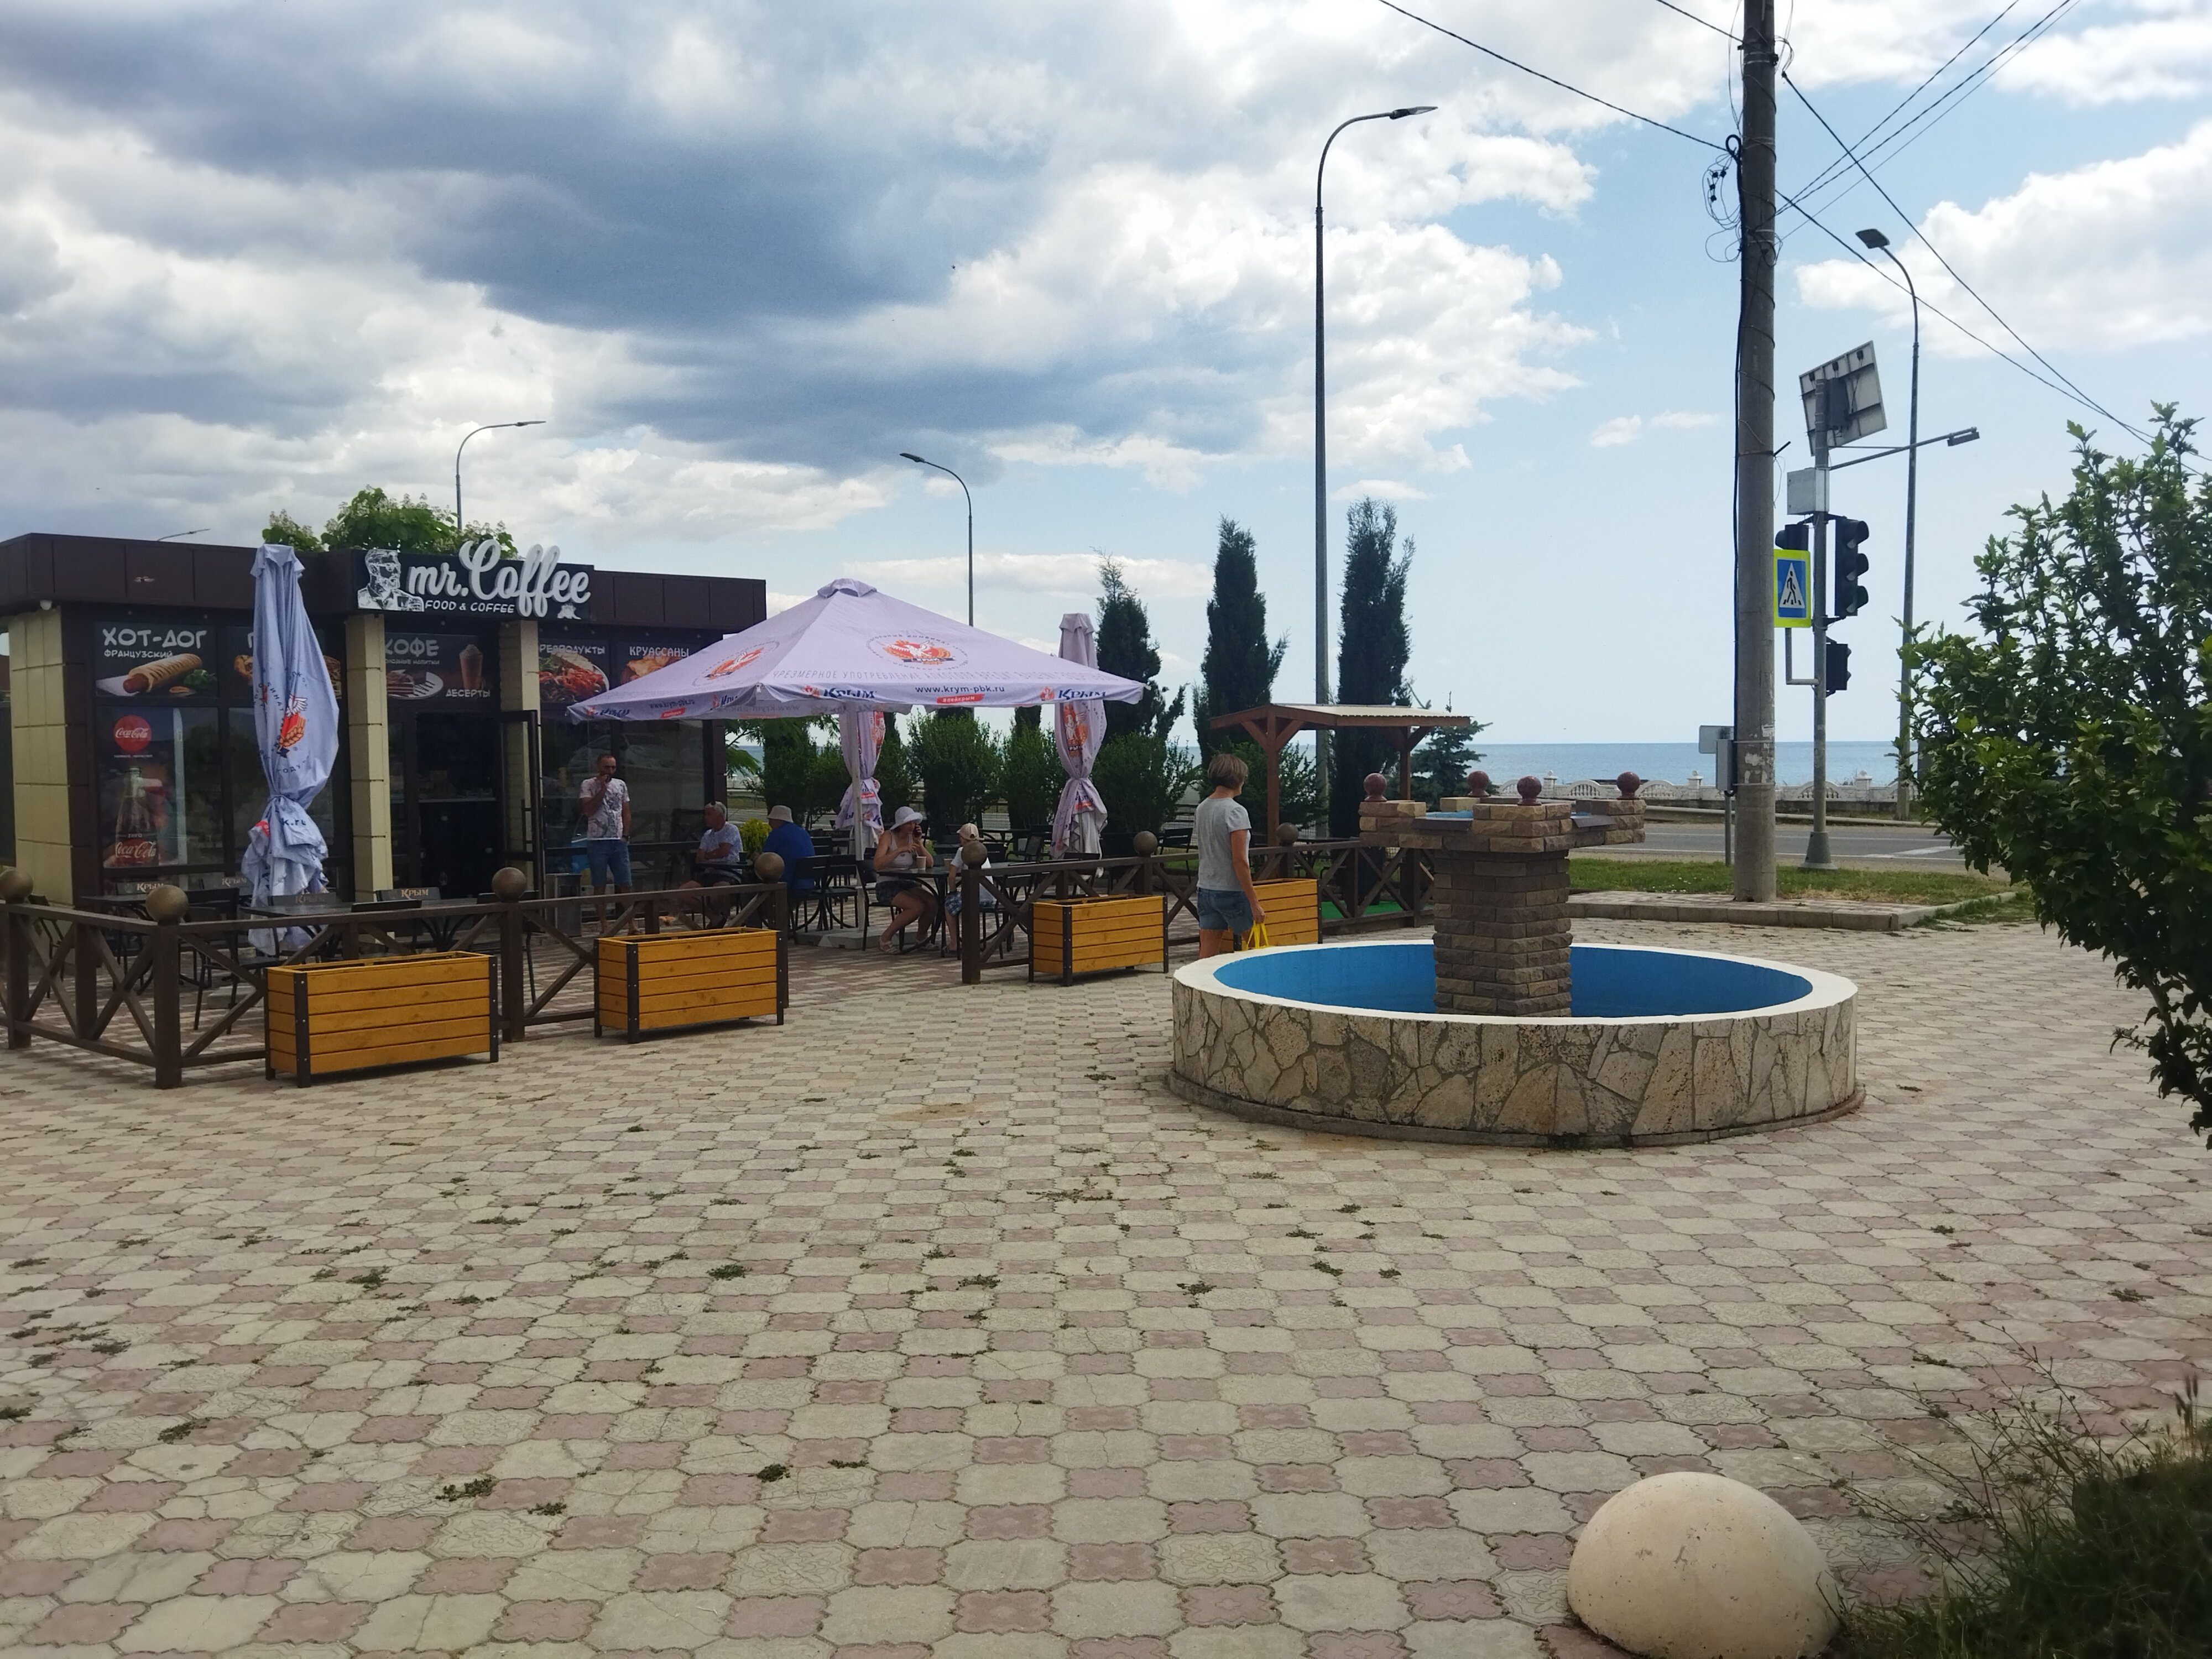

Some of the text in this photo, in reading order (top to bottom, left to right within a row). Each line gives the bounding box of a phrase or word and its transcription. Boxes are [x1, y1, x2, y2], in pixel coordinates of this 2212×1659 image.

[425, 600, 515, 614] FOOD & COFFEE
[103, 627, 207, 649] ХОТ-ДОГ
[104, 649, 173, 659] ФРАНЦУЗСКИЙ
[539, 644, 606, 655] РЕПРОДУКТЫ
[629, 646, 689, 658] КРУАССАНЫ
[773, 670, 837, 679] ЧРЕЗМЕРНОЕ
[843, 671, 922, 680] УПОТРЕБЛЕНИЕ
[446, 689, 491, 697] ДЕСЕРТЫ
[915, 685, 1005, 694] www.krym-pbk.ru
